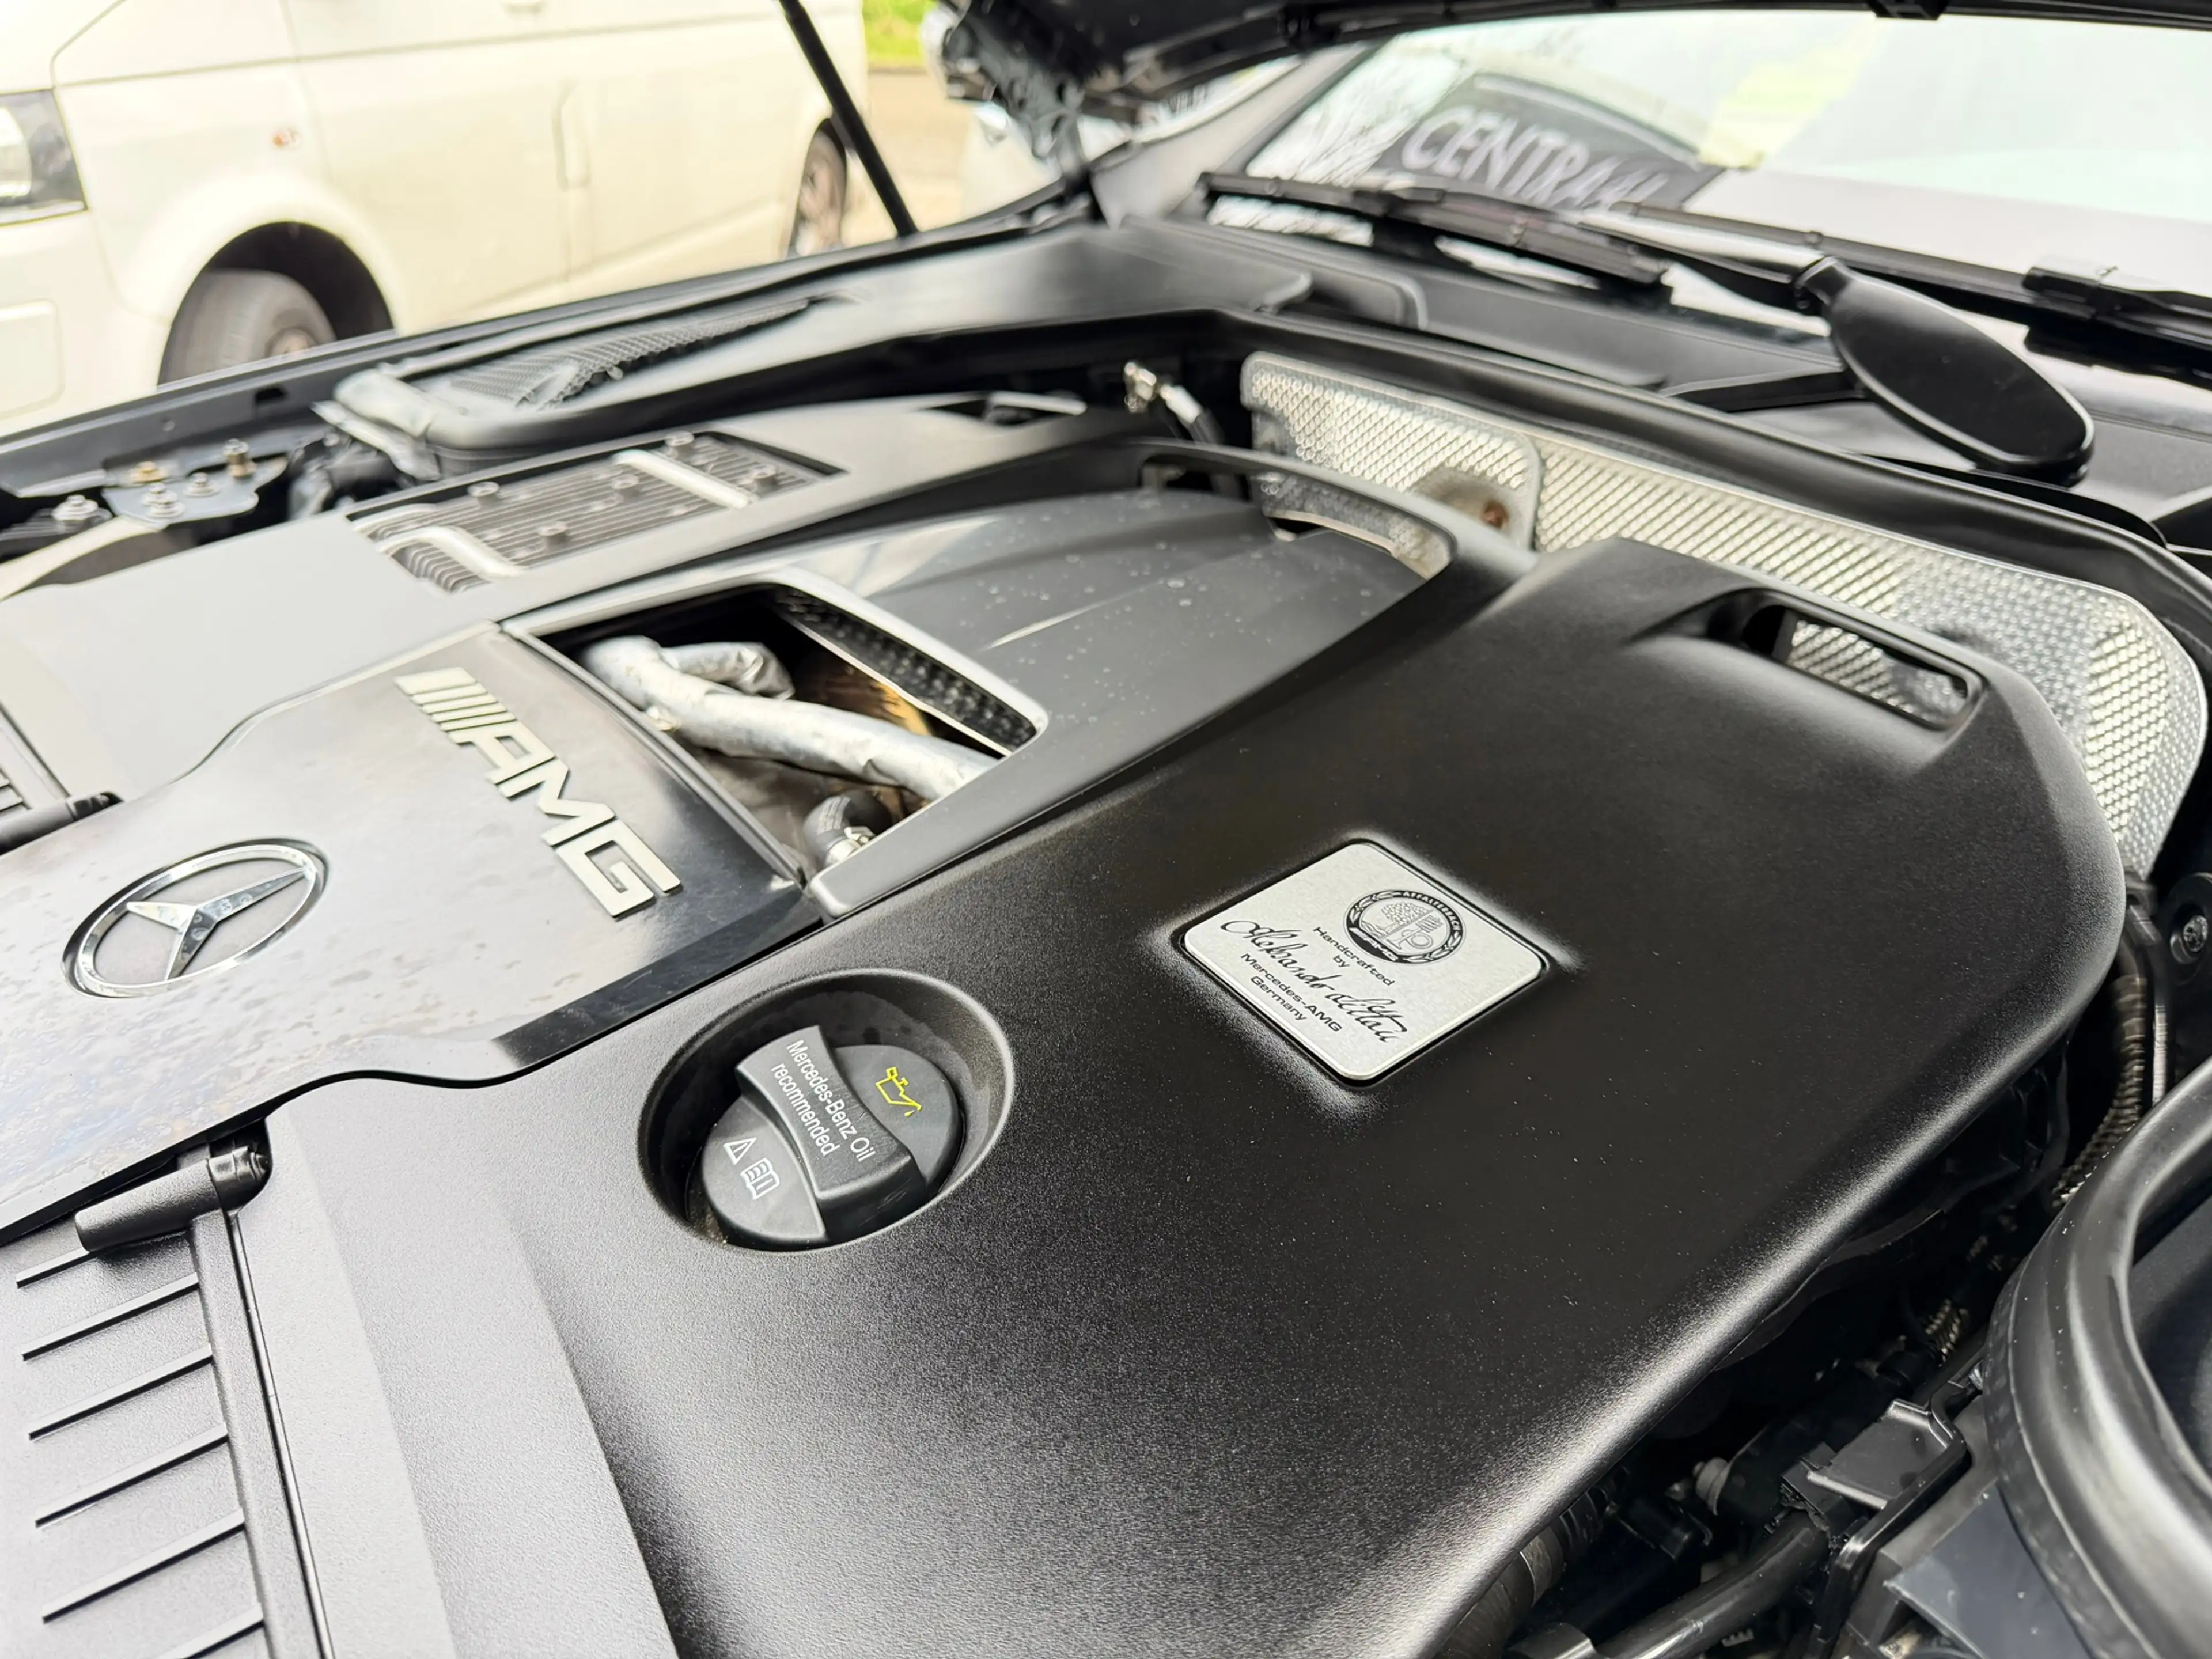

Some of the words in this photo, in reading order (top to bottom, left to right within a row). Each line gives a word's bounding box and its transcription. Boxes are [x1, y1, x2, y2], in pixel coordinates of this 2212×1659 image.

[448, 720, 682, 918] AMG
[1240, 953, 1343, 1032] Mercedes-AMG
[1313, 926, 1395, 986] Handcrafted
[1332, 955, 1350, 968] by
[1250, 976, 1308, 1021] Germany
[771, 1062, 842, 1156] recommended
[786, 1039, 857, 1140] Mercedes-Benz
[850, 1135, 876, 1162] Oil
